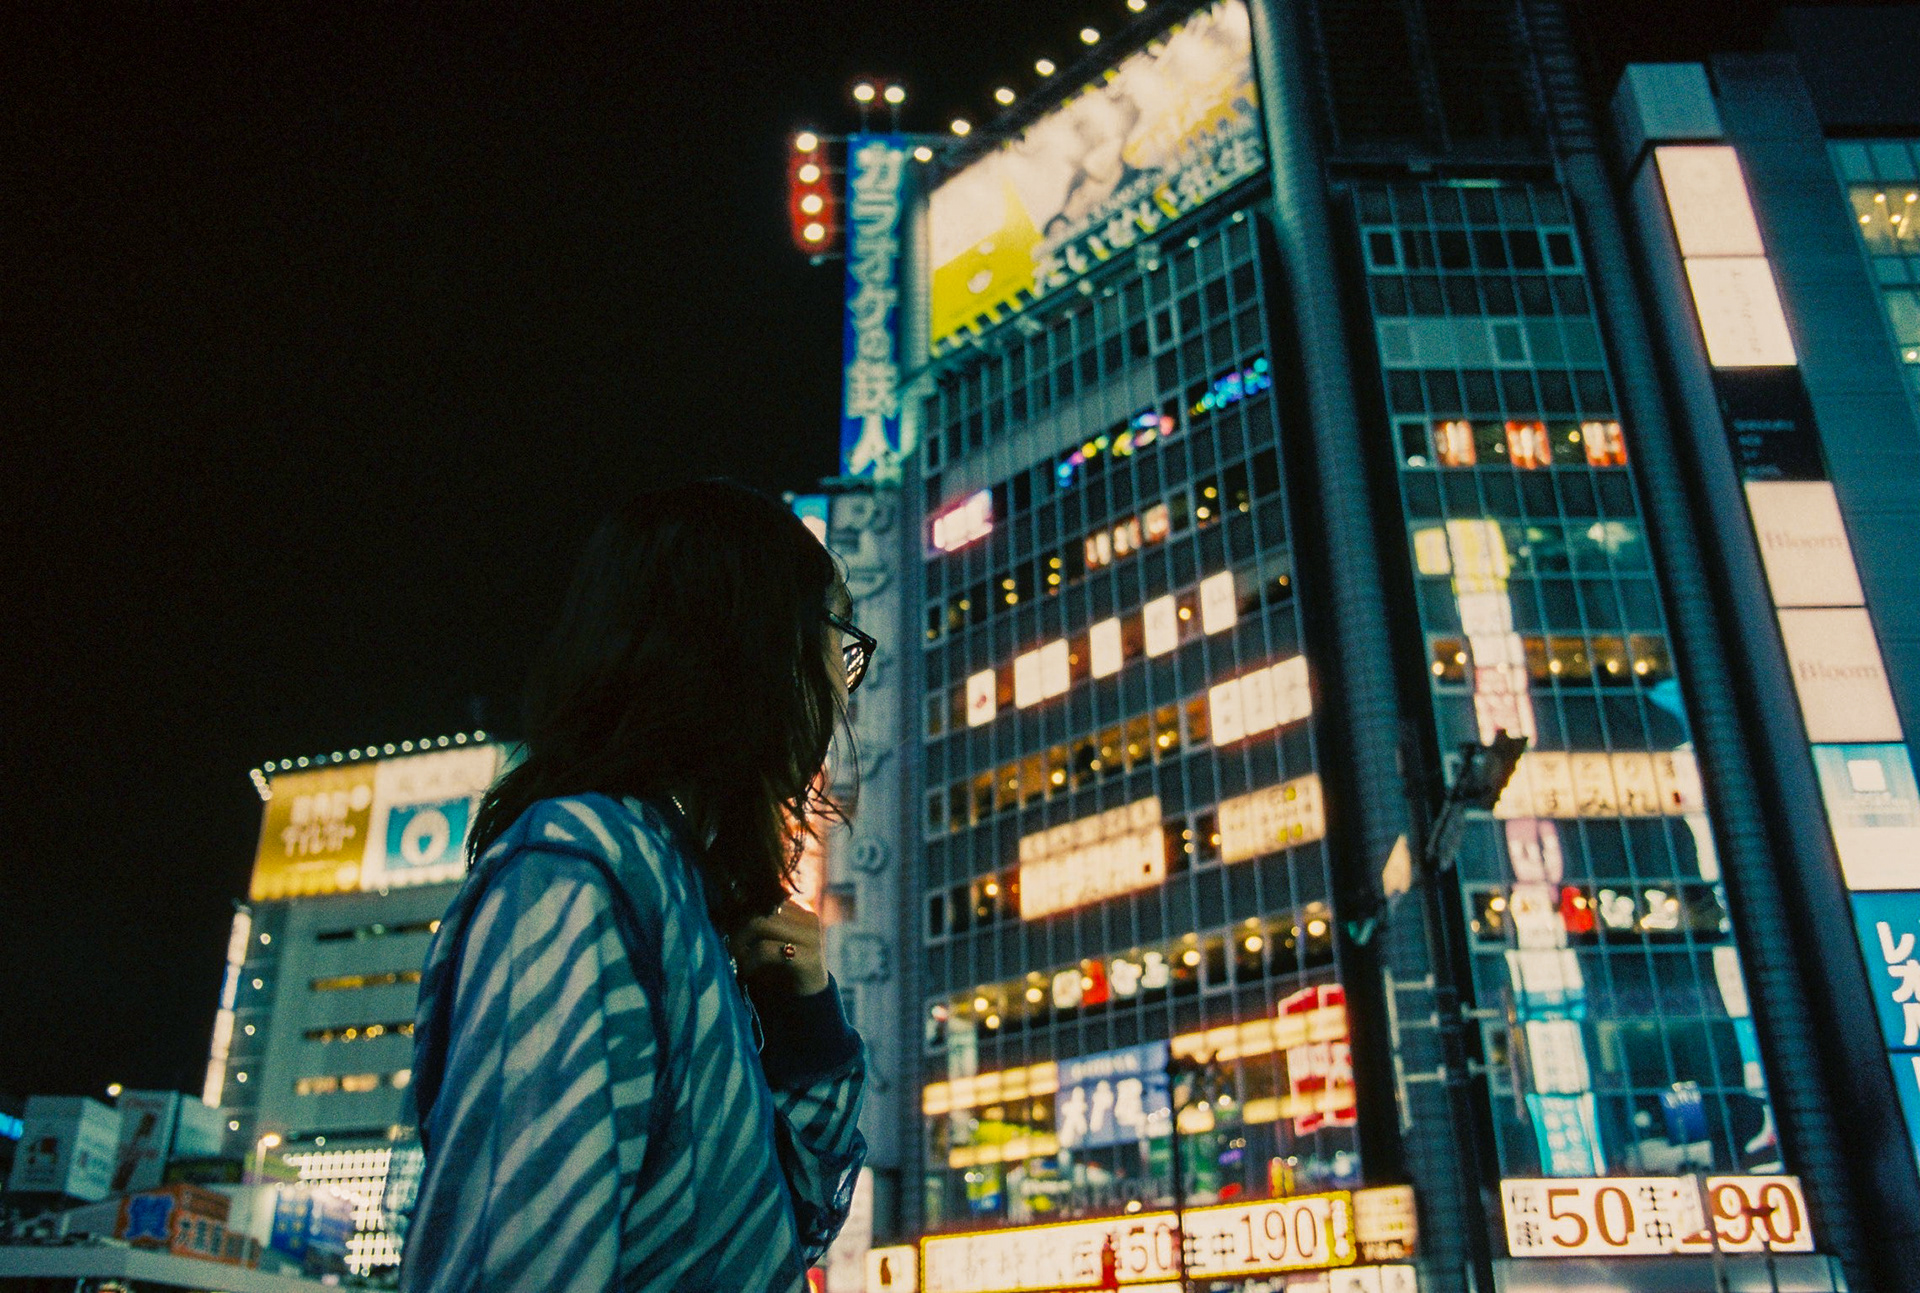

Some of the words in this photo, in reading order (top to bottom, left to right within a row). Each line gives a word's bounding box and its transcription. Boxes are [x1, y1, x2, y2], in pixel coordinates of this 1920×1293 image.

[1764, 530, 1844, 551] Bloom
[1798, 660, 1880, 682] Bloom
[1242, 1206, 1317, 1264] 190
[1547, 1185, 1635, 1248] 50
